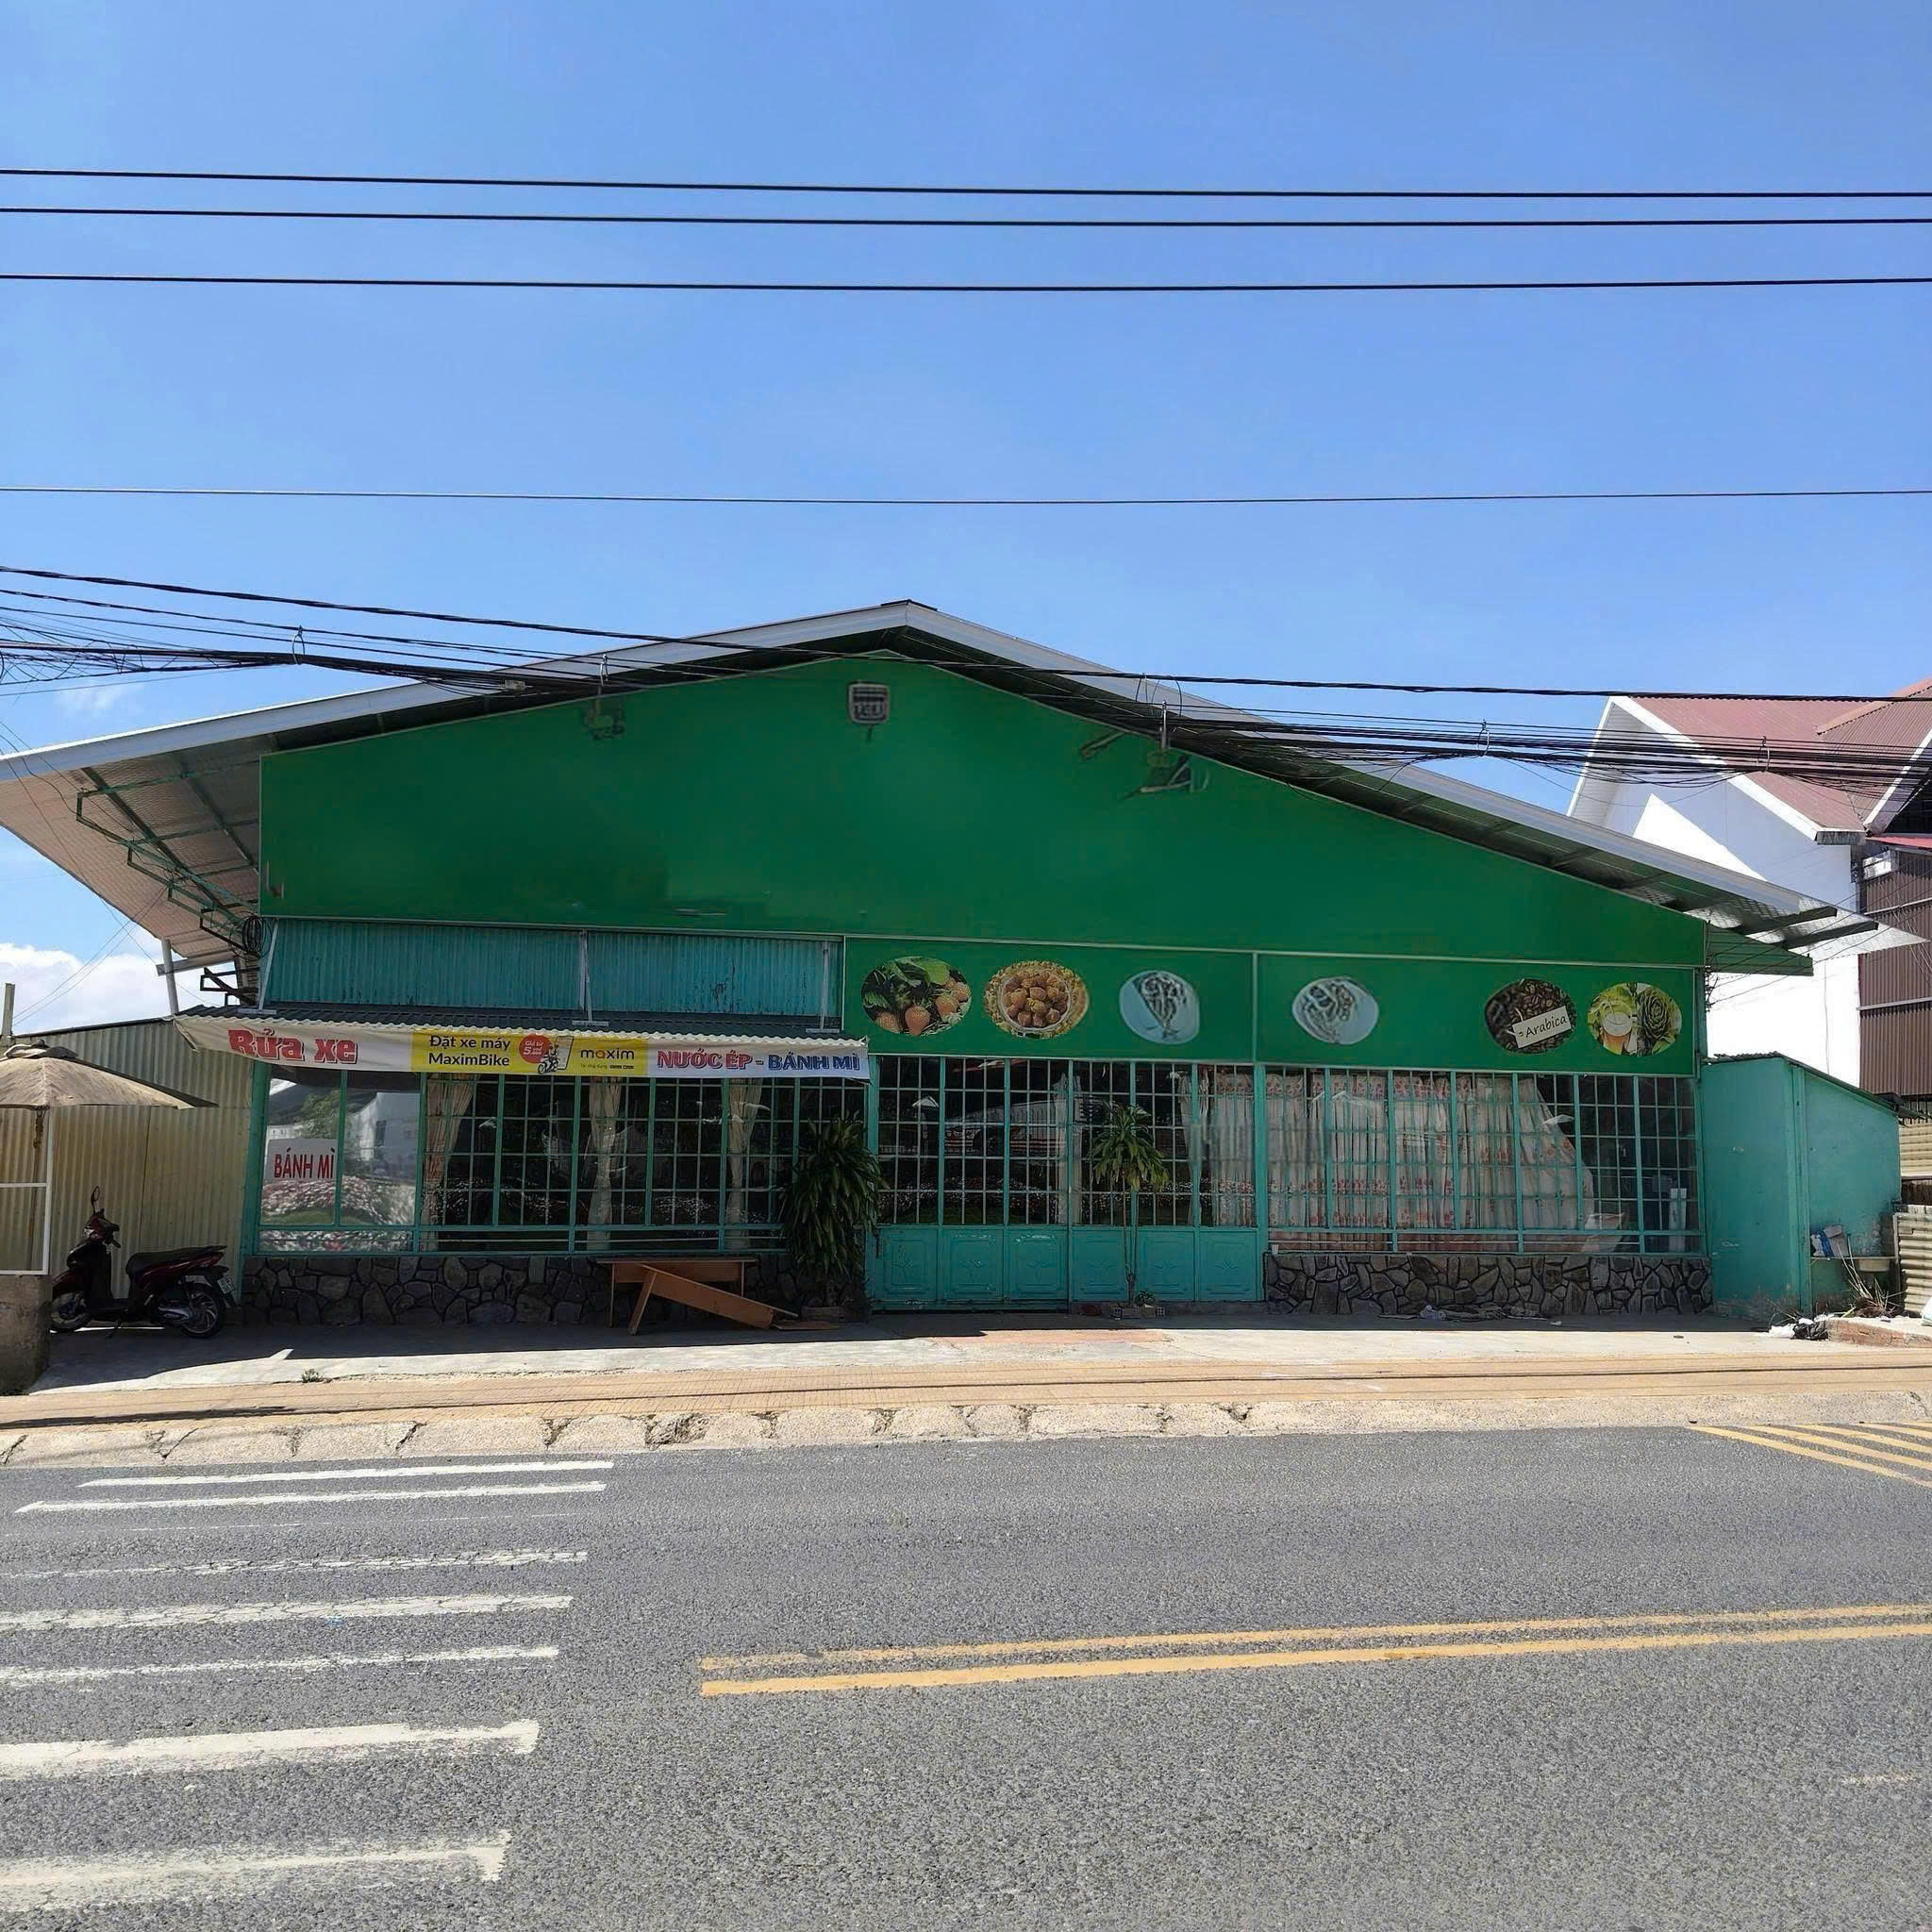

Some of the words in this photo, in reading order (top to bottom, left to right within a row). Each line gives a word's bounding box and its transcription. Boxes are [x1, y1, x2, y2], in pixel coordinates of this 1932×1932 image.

[1525, 1015, 1568, 1038] Arabica
[227, 1028, 305, 1061] Rửa
[313, 1039, 358, 1064] xe
[428, 1035, 457, 1049] Đặt
[459, 1039, 477, 1048] xe
[480, 1037, 511, 1051] máy
[580, 1047, 635, 1059] maxim
[428, 1052, 510, 1066] MaximBike
[768, 1051, 830, 1071] BÁNH
[832, 1052, 860, 1071] MÌ
[274, 1147, 314, 1178] BÁNH
[317, 1147, 336, 1179] MÌ
